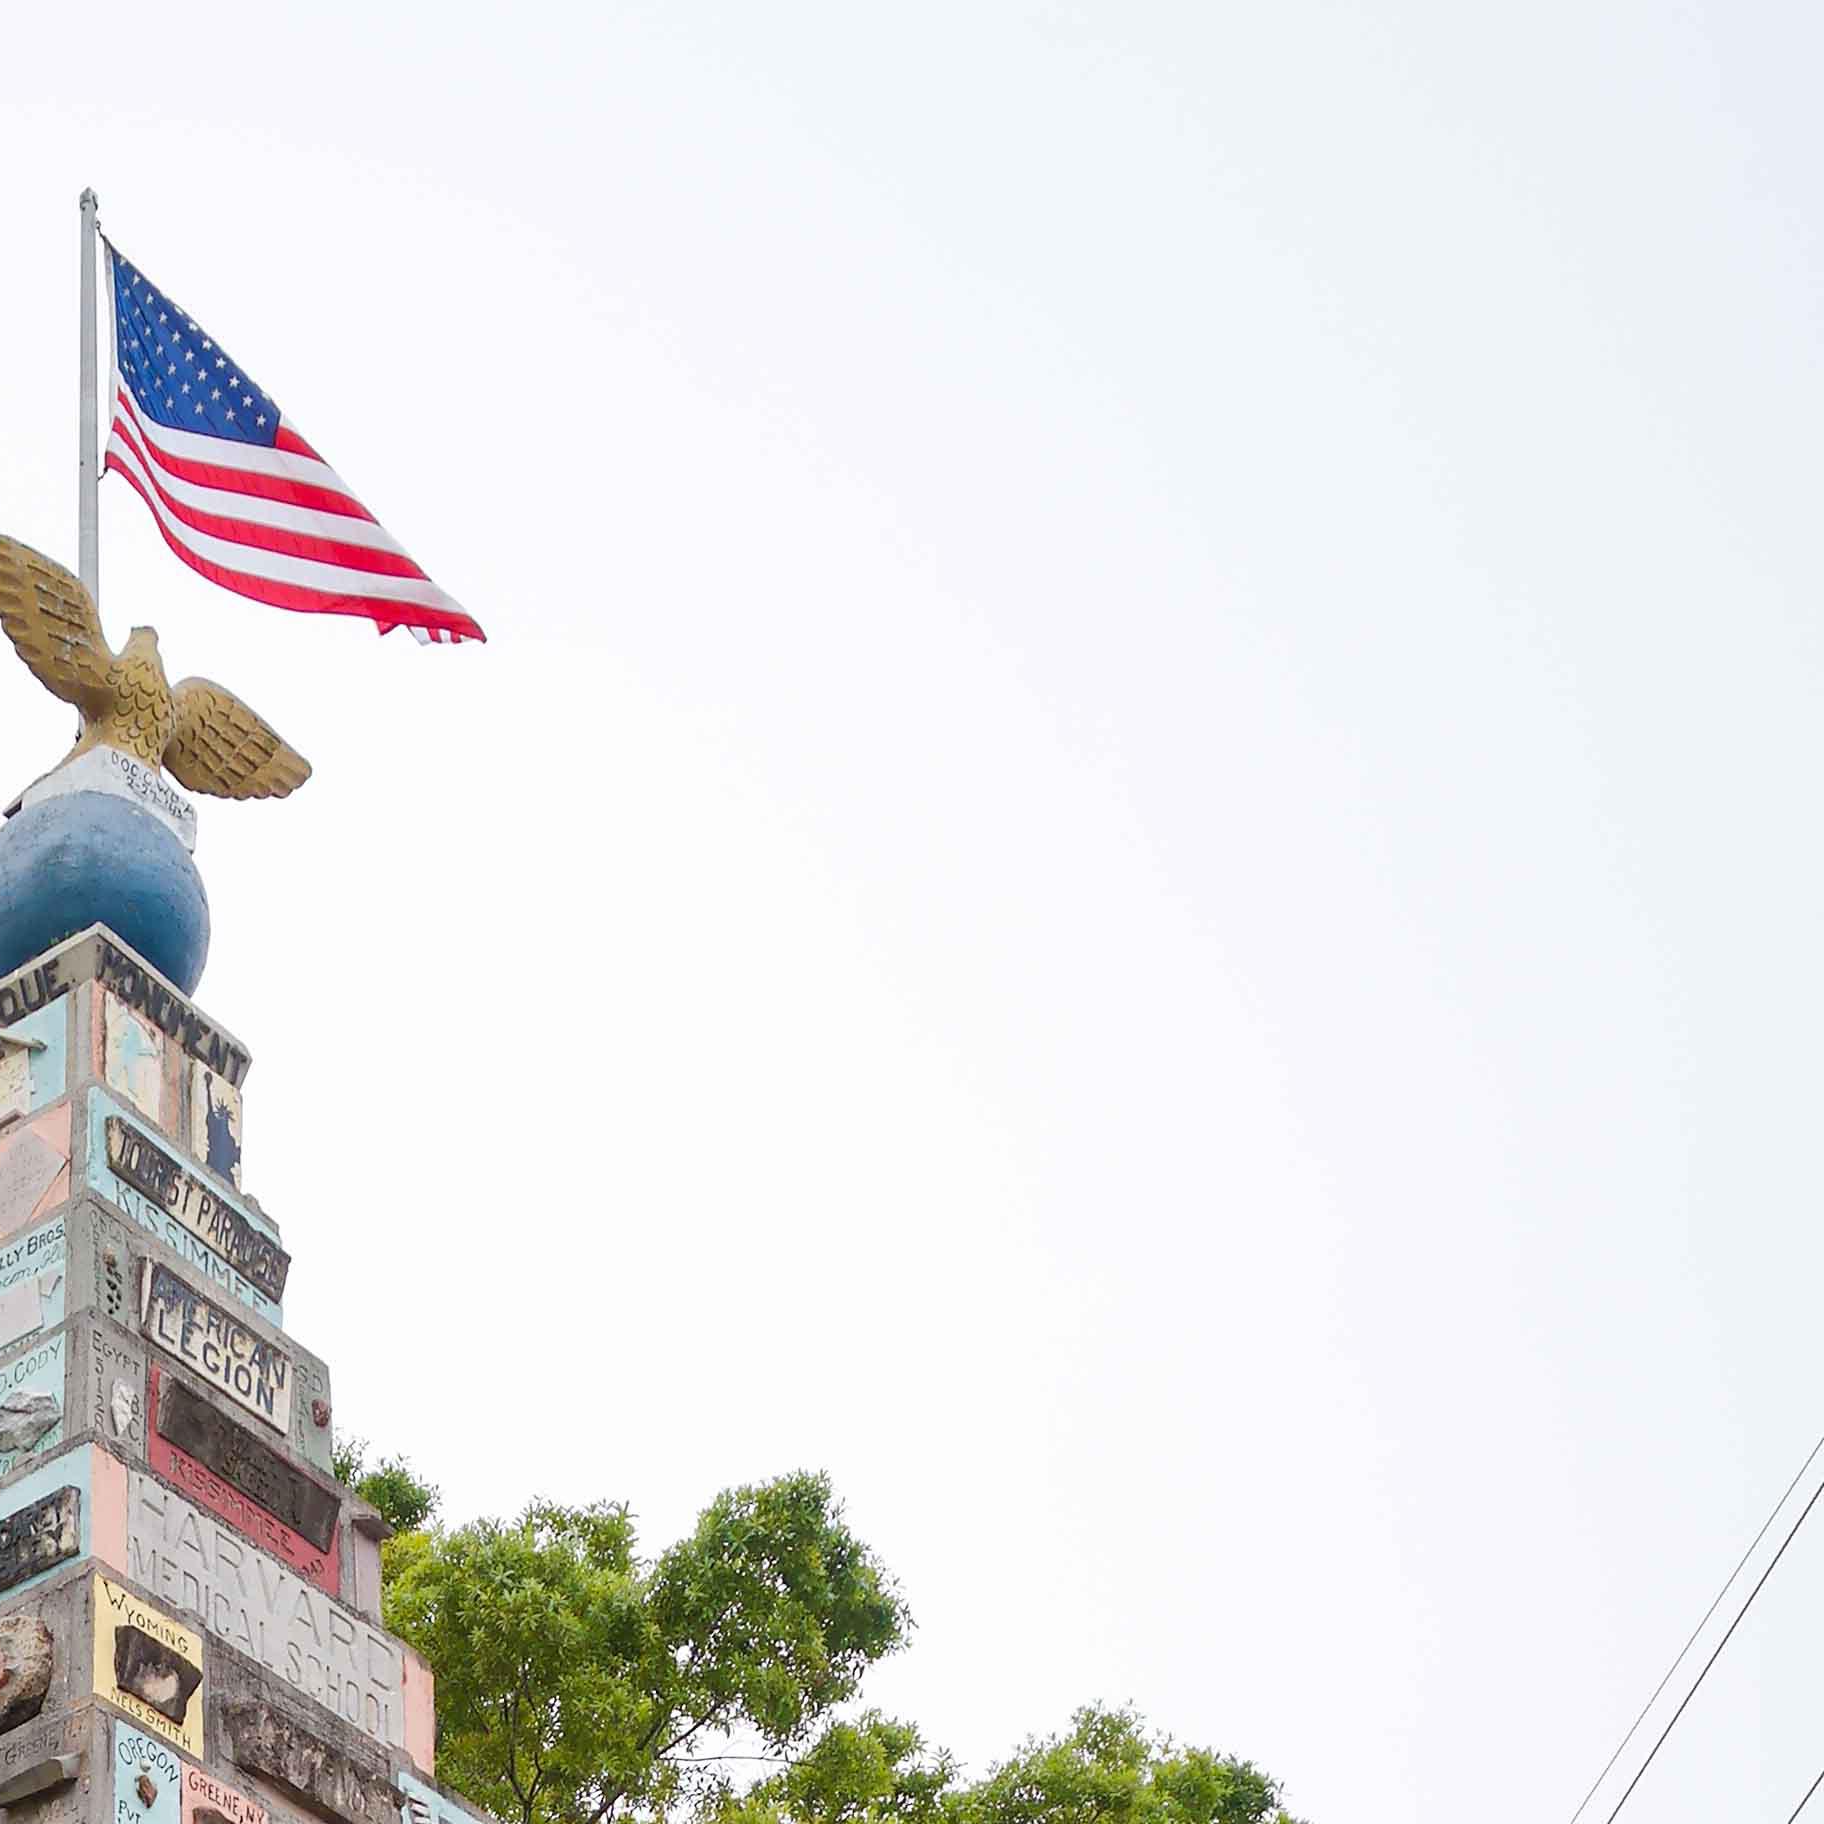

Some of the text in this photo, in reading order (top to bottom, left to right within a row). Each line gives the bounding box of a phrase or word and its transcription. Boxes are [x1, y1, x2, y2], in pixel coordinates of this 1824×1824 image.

[97, 941, 249, 1084] MONUMENT
[115, 1181, 267, 1308] KISSIMMEE
[119, 1128, 193, 1215] TOURIST
[198, 1196, 283, 1295] PARADISE
[155, 1271, 286, 1388] AMERICAN
[158, 1308, 274, 1417] LEGION
[170, 1450, 292, 1550] KISSIMMEE
[103, 1581, 189, 1654] WYOMING
[127, 1536, 273, 1669] MEDICAL
[286, 1641, 391, 1737] SCHOOL
[138, 1478, 396, 1692] HARVARD
[110, 1686, 192, 1751] NELS SMITH
[118, 1738, 179, 1783] OREGON
